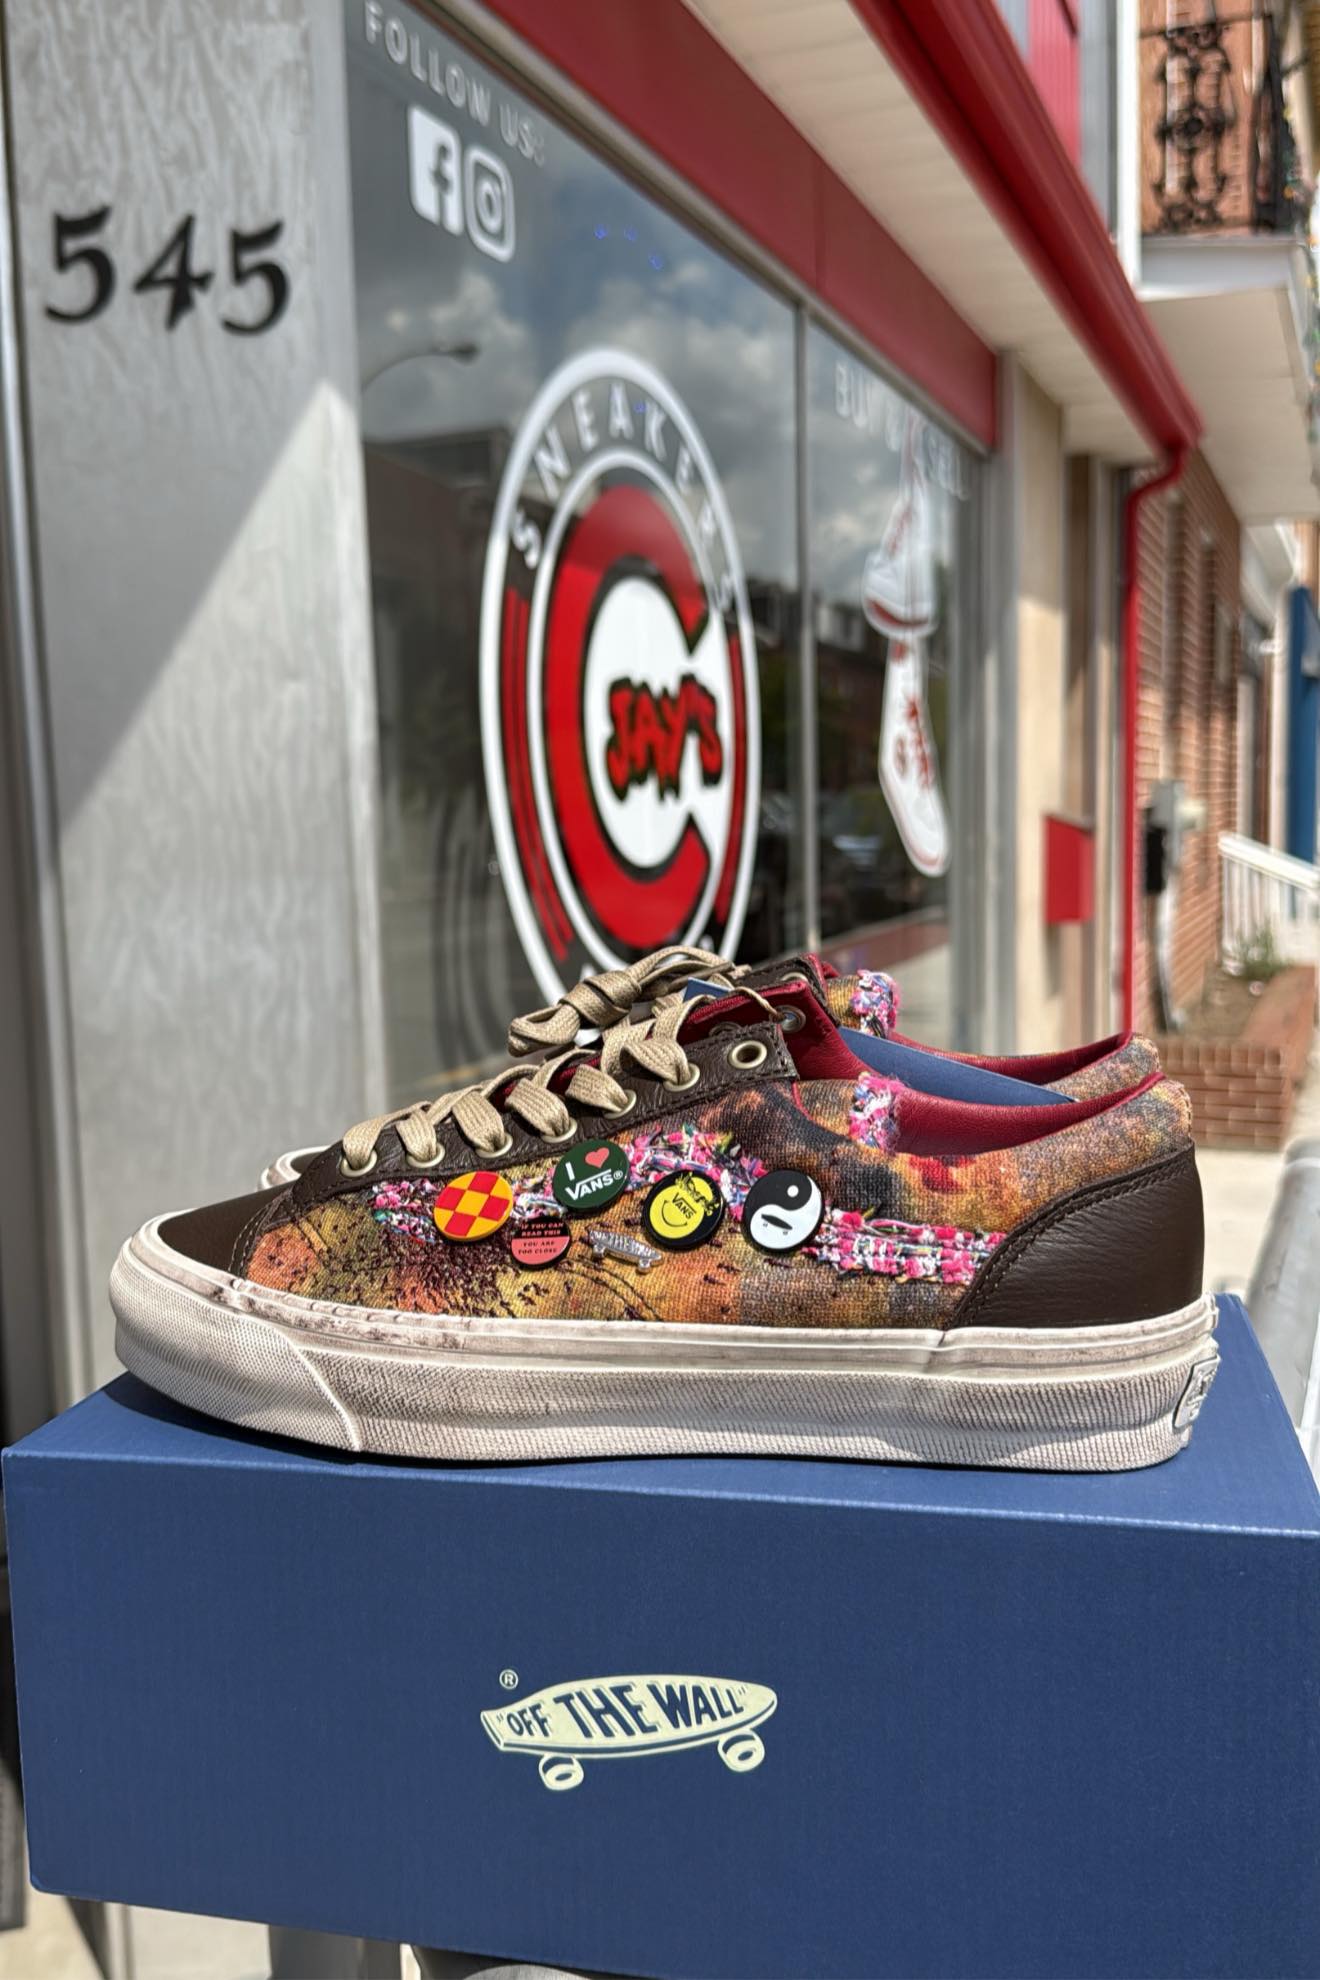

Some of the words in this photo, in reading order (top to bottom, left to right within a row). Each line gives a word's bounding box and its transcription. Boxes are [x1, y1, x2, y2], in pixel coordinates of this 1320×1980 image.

[365, 0, 492, 126] FOLLOW
[44, 206, 291, 335] 545
[565, 1161, 576, 1181] I
[531, 1222, 547, 1230] YOU
[672, 1192, 698, 1219] VANS
[553, 1682, 660, 1739] THE
